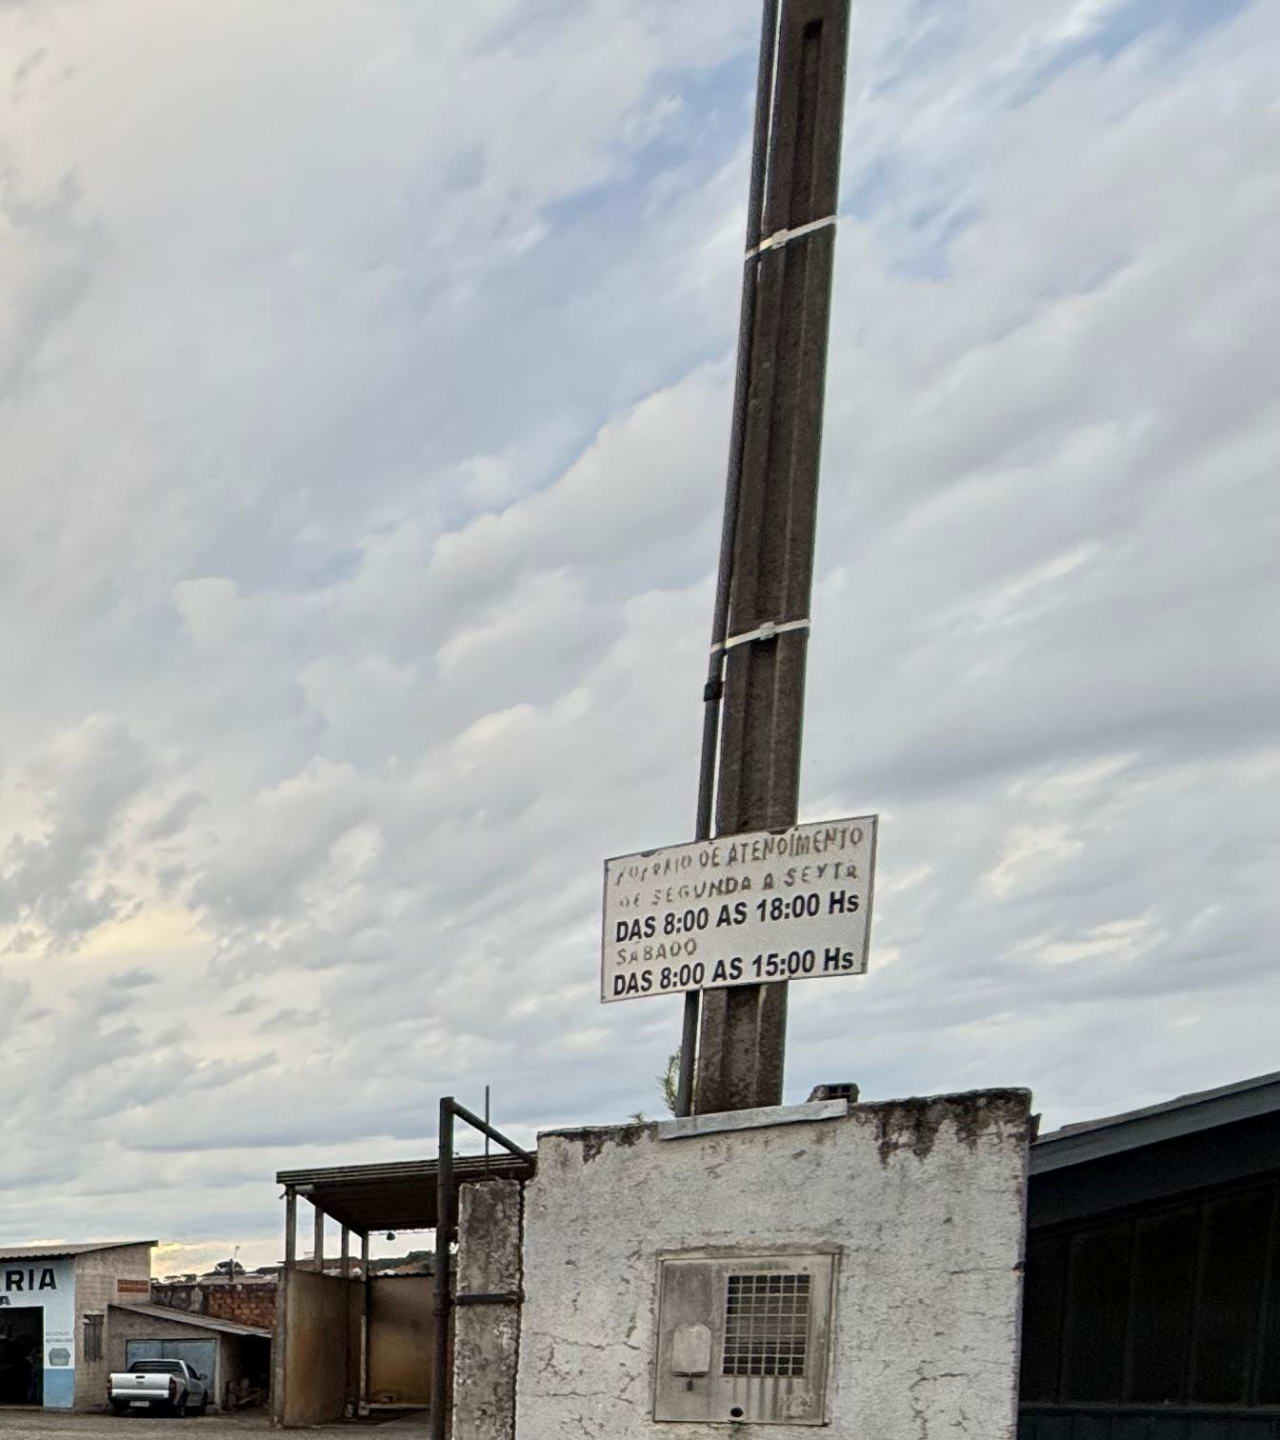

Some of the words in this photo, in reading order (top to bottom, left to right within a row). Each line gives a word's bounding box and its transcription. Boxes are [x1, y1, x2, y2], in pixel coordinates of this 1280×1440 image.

[698, 846, 720, 868] DE
[762, 872, 774, 891] A
[616, 915, 656, 943] DAS
[663, 907, 709, 936] 8:00
[716, 901, 748, 928] AS
[756, 892, 820, 923] 18:00
[828, 889, 860, 914] Hs
[613, 968, 653, 996] DAS
[660, 961, 706, 990] 8:00
[711, 956, 743, 982] AS
[752, 949, 816, 978] 15:00
[823, 947, 854, 972] Hs
